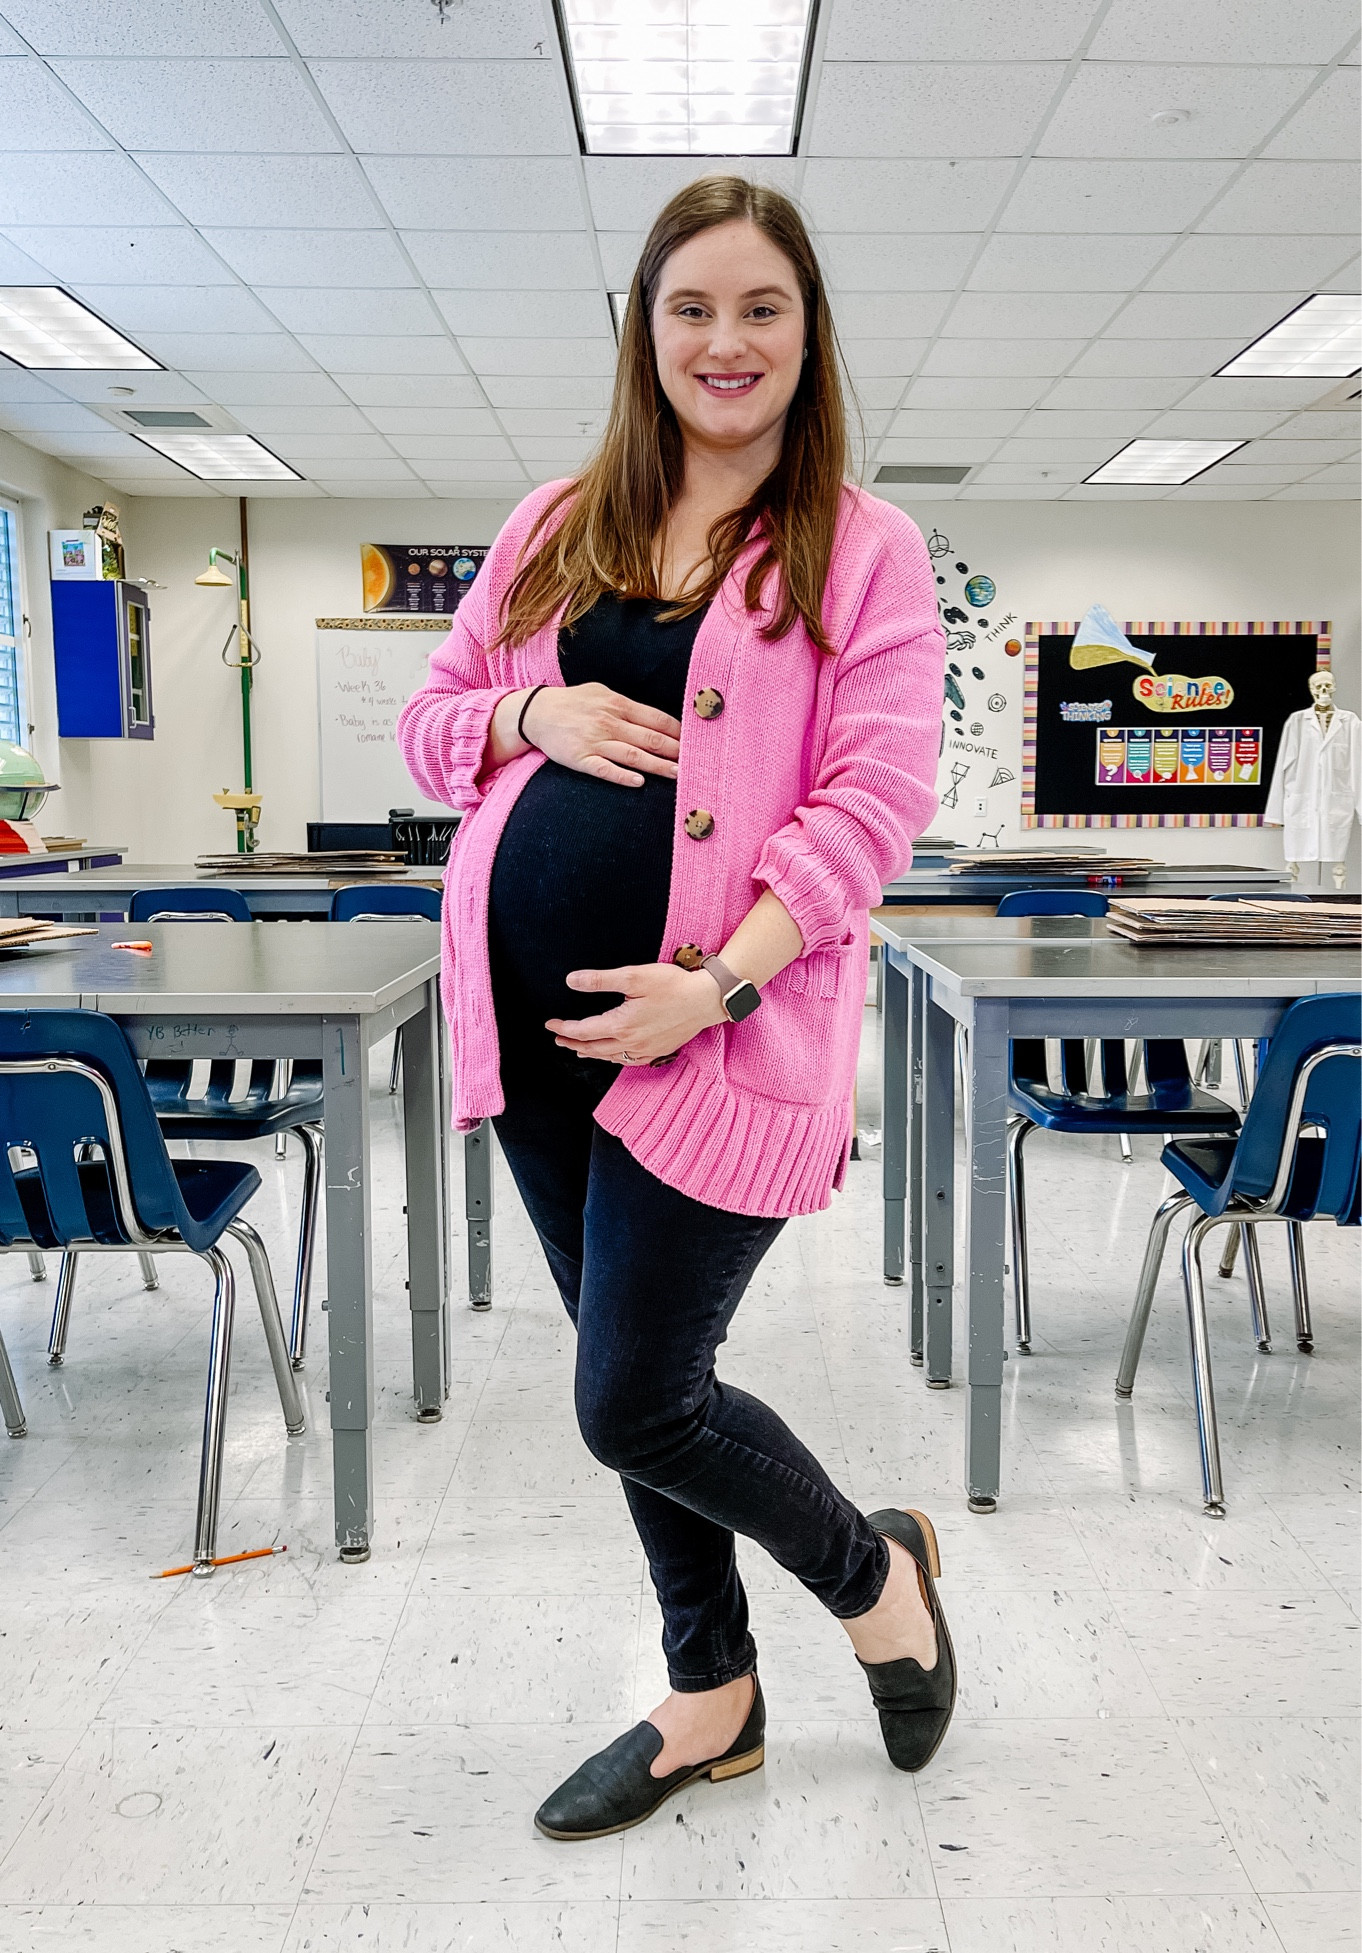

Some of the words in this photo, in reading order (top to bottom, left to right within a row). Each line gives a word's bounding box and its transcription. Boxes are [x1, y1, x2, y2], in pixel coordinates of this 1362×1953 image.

[408, 548, 429, 556] OUR
[430, 548, 460, 557] SOLAR
[461, 549, 489, 557] SYSTE
[984, 612, 1018, 643] THINK
[375, 680, 386, 692] 36
[1139, 677, 1225, 697] Science
[1170, 688, 1231, 710] Rules!
[340, 714, 366, 731] Baby
[1060, 711, 1112, 722] THINKING
[949, 739, 999, 760] INNOVATE
